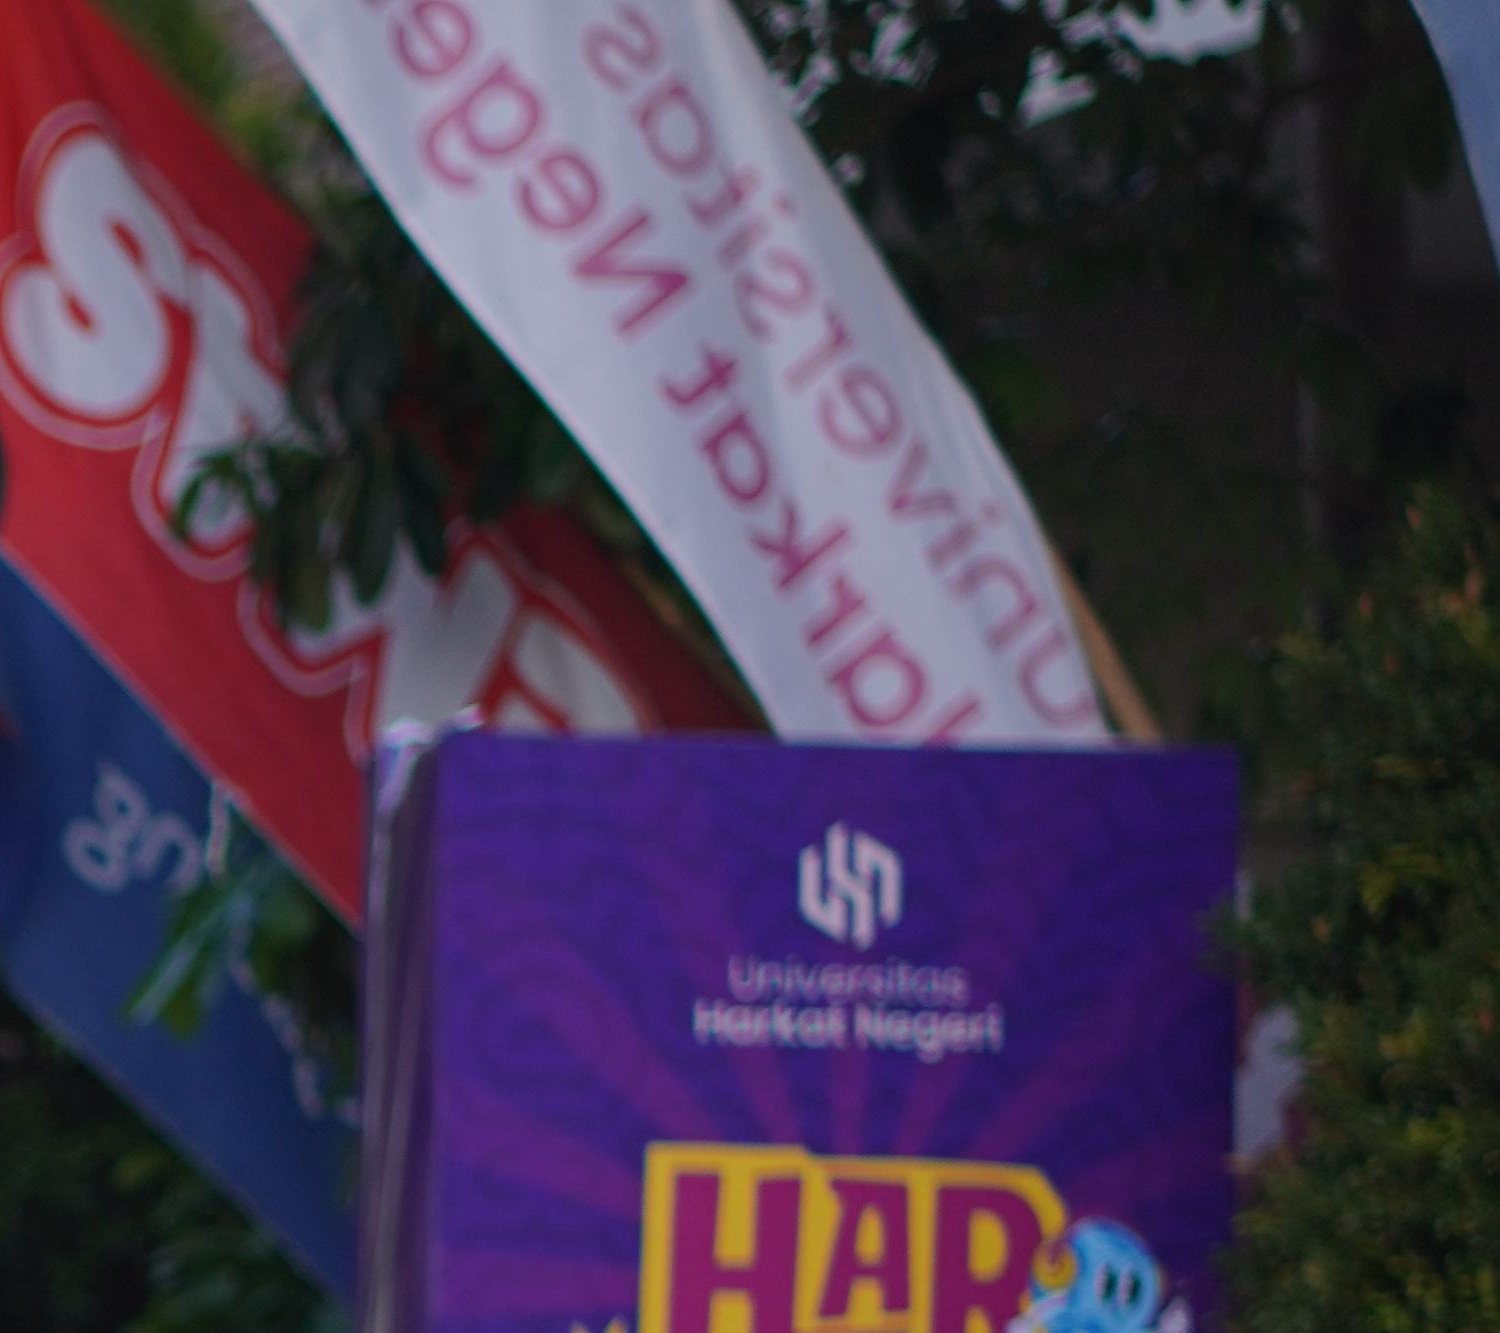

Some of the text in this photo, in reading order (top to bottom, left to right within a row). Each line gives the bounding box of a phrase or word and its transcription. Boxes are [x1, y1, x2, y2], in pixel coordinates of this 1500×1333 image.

[727, 955, 970, 1003] Universitas
[693, 1002, 1003, 1062] Harkat Negeri
